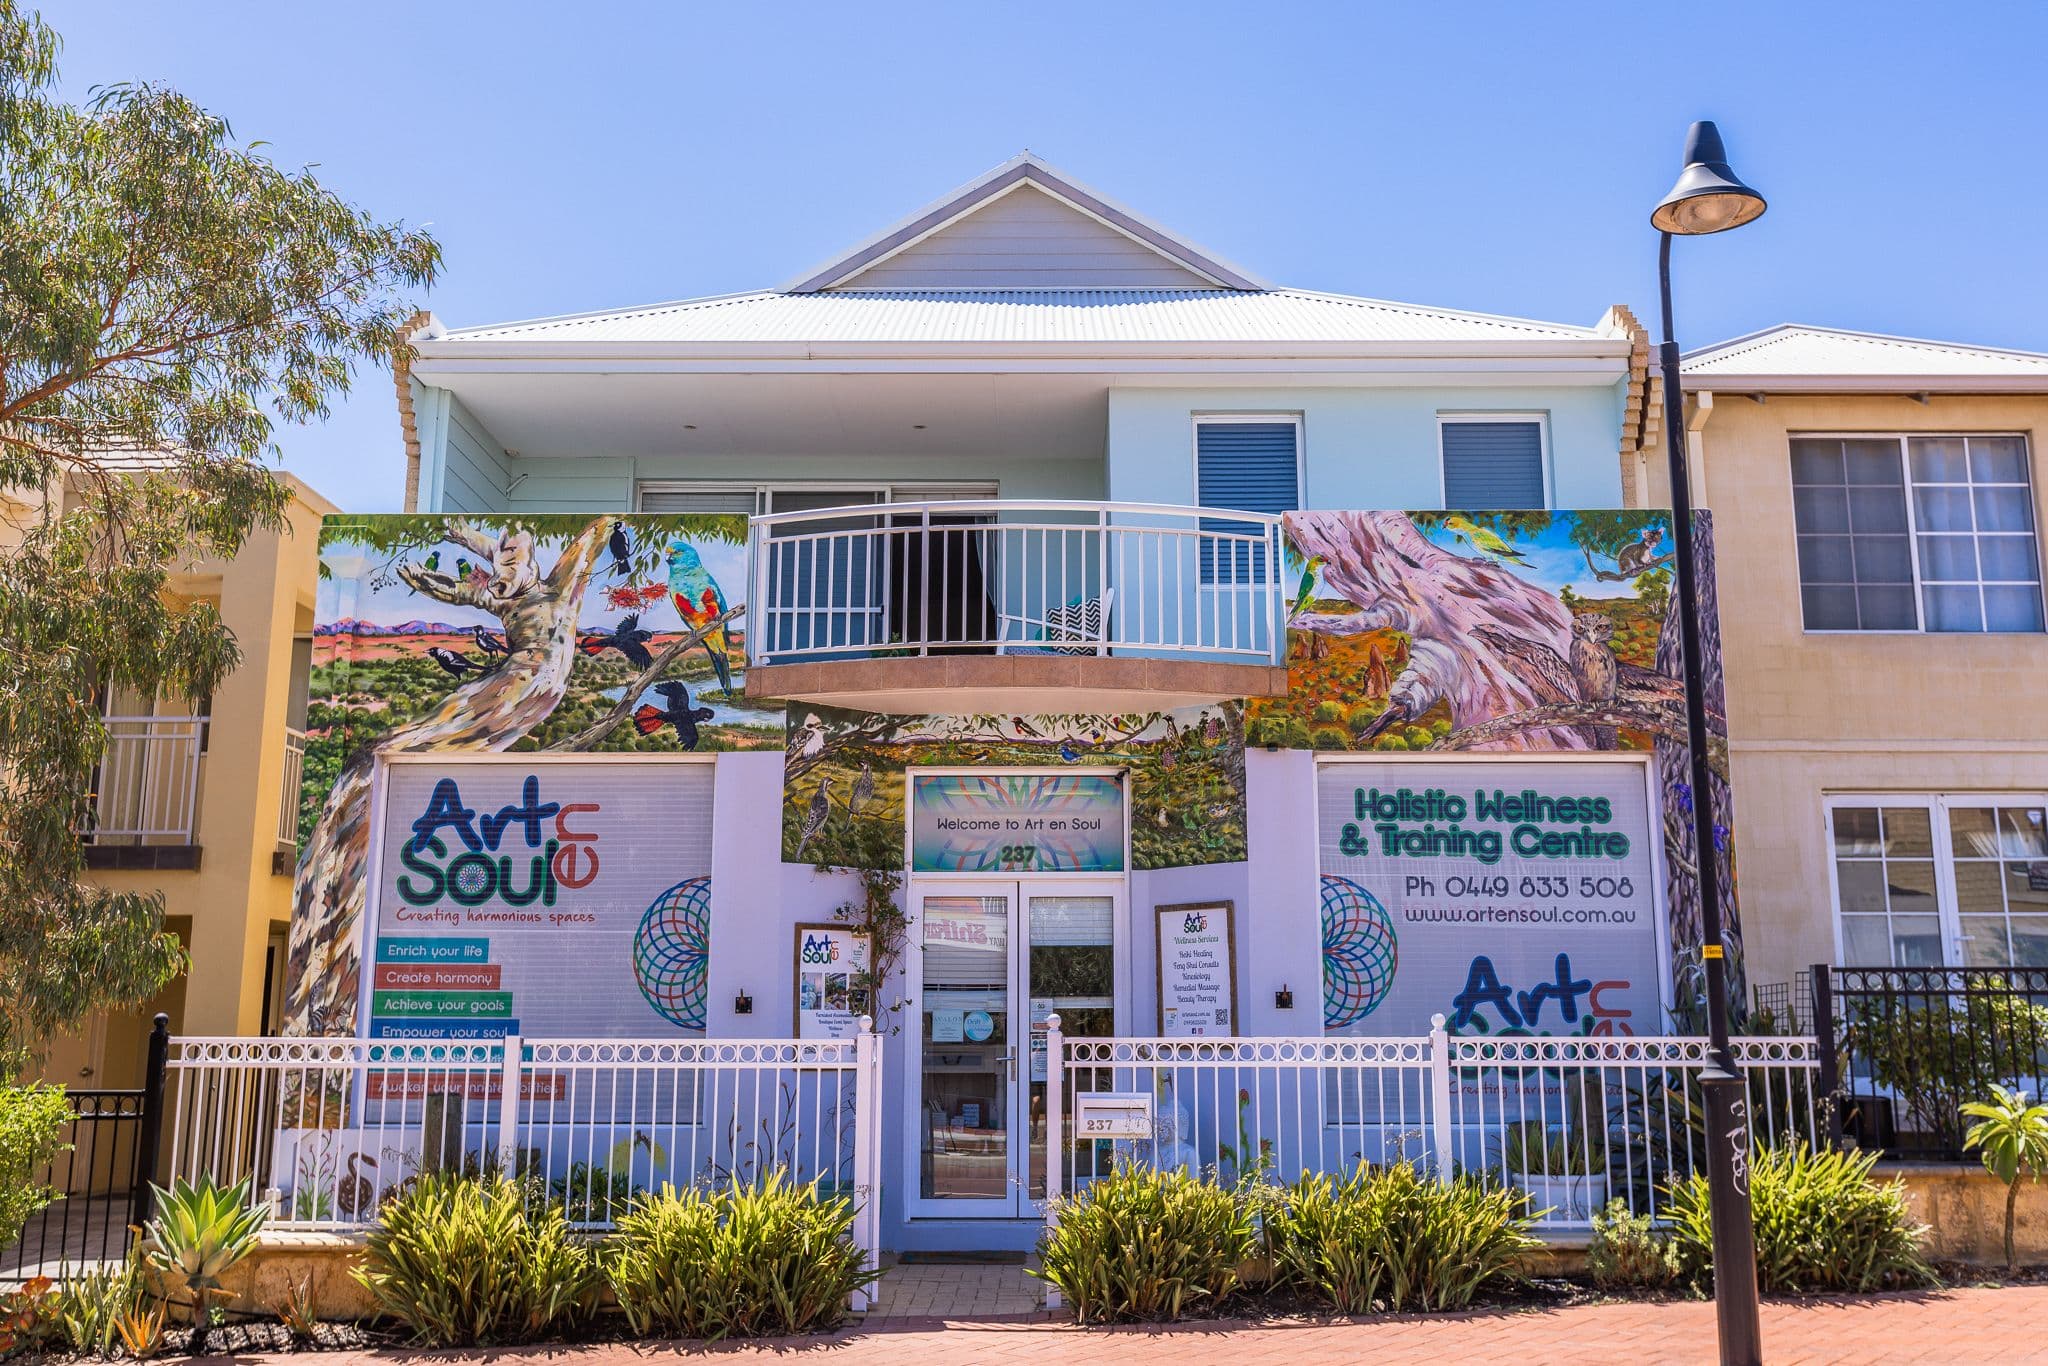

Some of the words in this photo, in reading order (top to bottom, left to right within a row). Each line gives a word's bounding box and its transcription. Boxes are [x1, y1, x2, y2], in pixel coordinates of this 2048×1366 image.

[411, 775, 560, 852] Art
[1354, 788, 1467, 822] Holistic
[1475, 789, 1612, 824] Wellness
[937, 818, 1000, 831] Welcome
[1006, 818, 1019, 831] to
[1025, 818, 1044, 831] Art
[1049, 820, 1067, 831] en
[1071, 817, 1101, 831] Soul
[553, 803, 600, 889] en
[1339, 823, 1369, 857] &
[1375, 824, 1503, 865] Training
[1510, 824, 1630, 860] Centre
[1001, 845, 1036, 863] 237
[397, 835, 559, 906] Soul
[1405, 876, 1435, 897] Ph
[1445, 876, 1509, 898] 0449
[1519, 876, 1569, 898] 833
[1579, 876, 1634, 898] 508
[396, 907, 460, 926] Creating
[467, 906, 542, 922] harmonious
[549, 911, 595, 926] spaces
[1185, 912, 1202, 924] Art
[1405, 906, 1636, 923] www.artensoul.com.au
[1183, 922, 1203, 933] Soul
[388, 944, 427, 957] Enrich
[431, 946, 460, 958] your
[464, 945, 483, 957] life
[805, 934, 832, 952] Art
[802, 948, 832, 965] Soul
[386, 971, 431, 984] Create
[436, 971, 492, 986] harmony
[1453, 953, 1593, 1028] Art
[384, 998, 433, 1011] Achieve
[437, 1001, 464, 1013] your
[470, 999, 505, 1013] goals
[382, 1026, 444, 1039] Empower
[450, 1028, 479, 1039] your
[483, 1026, 508, 1038] soul
[1087, 1119, 1113, 1131] 237
